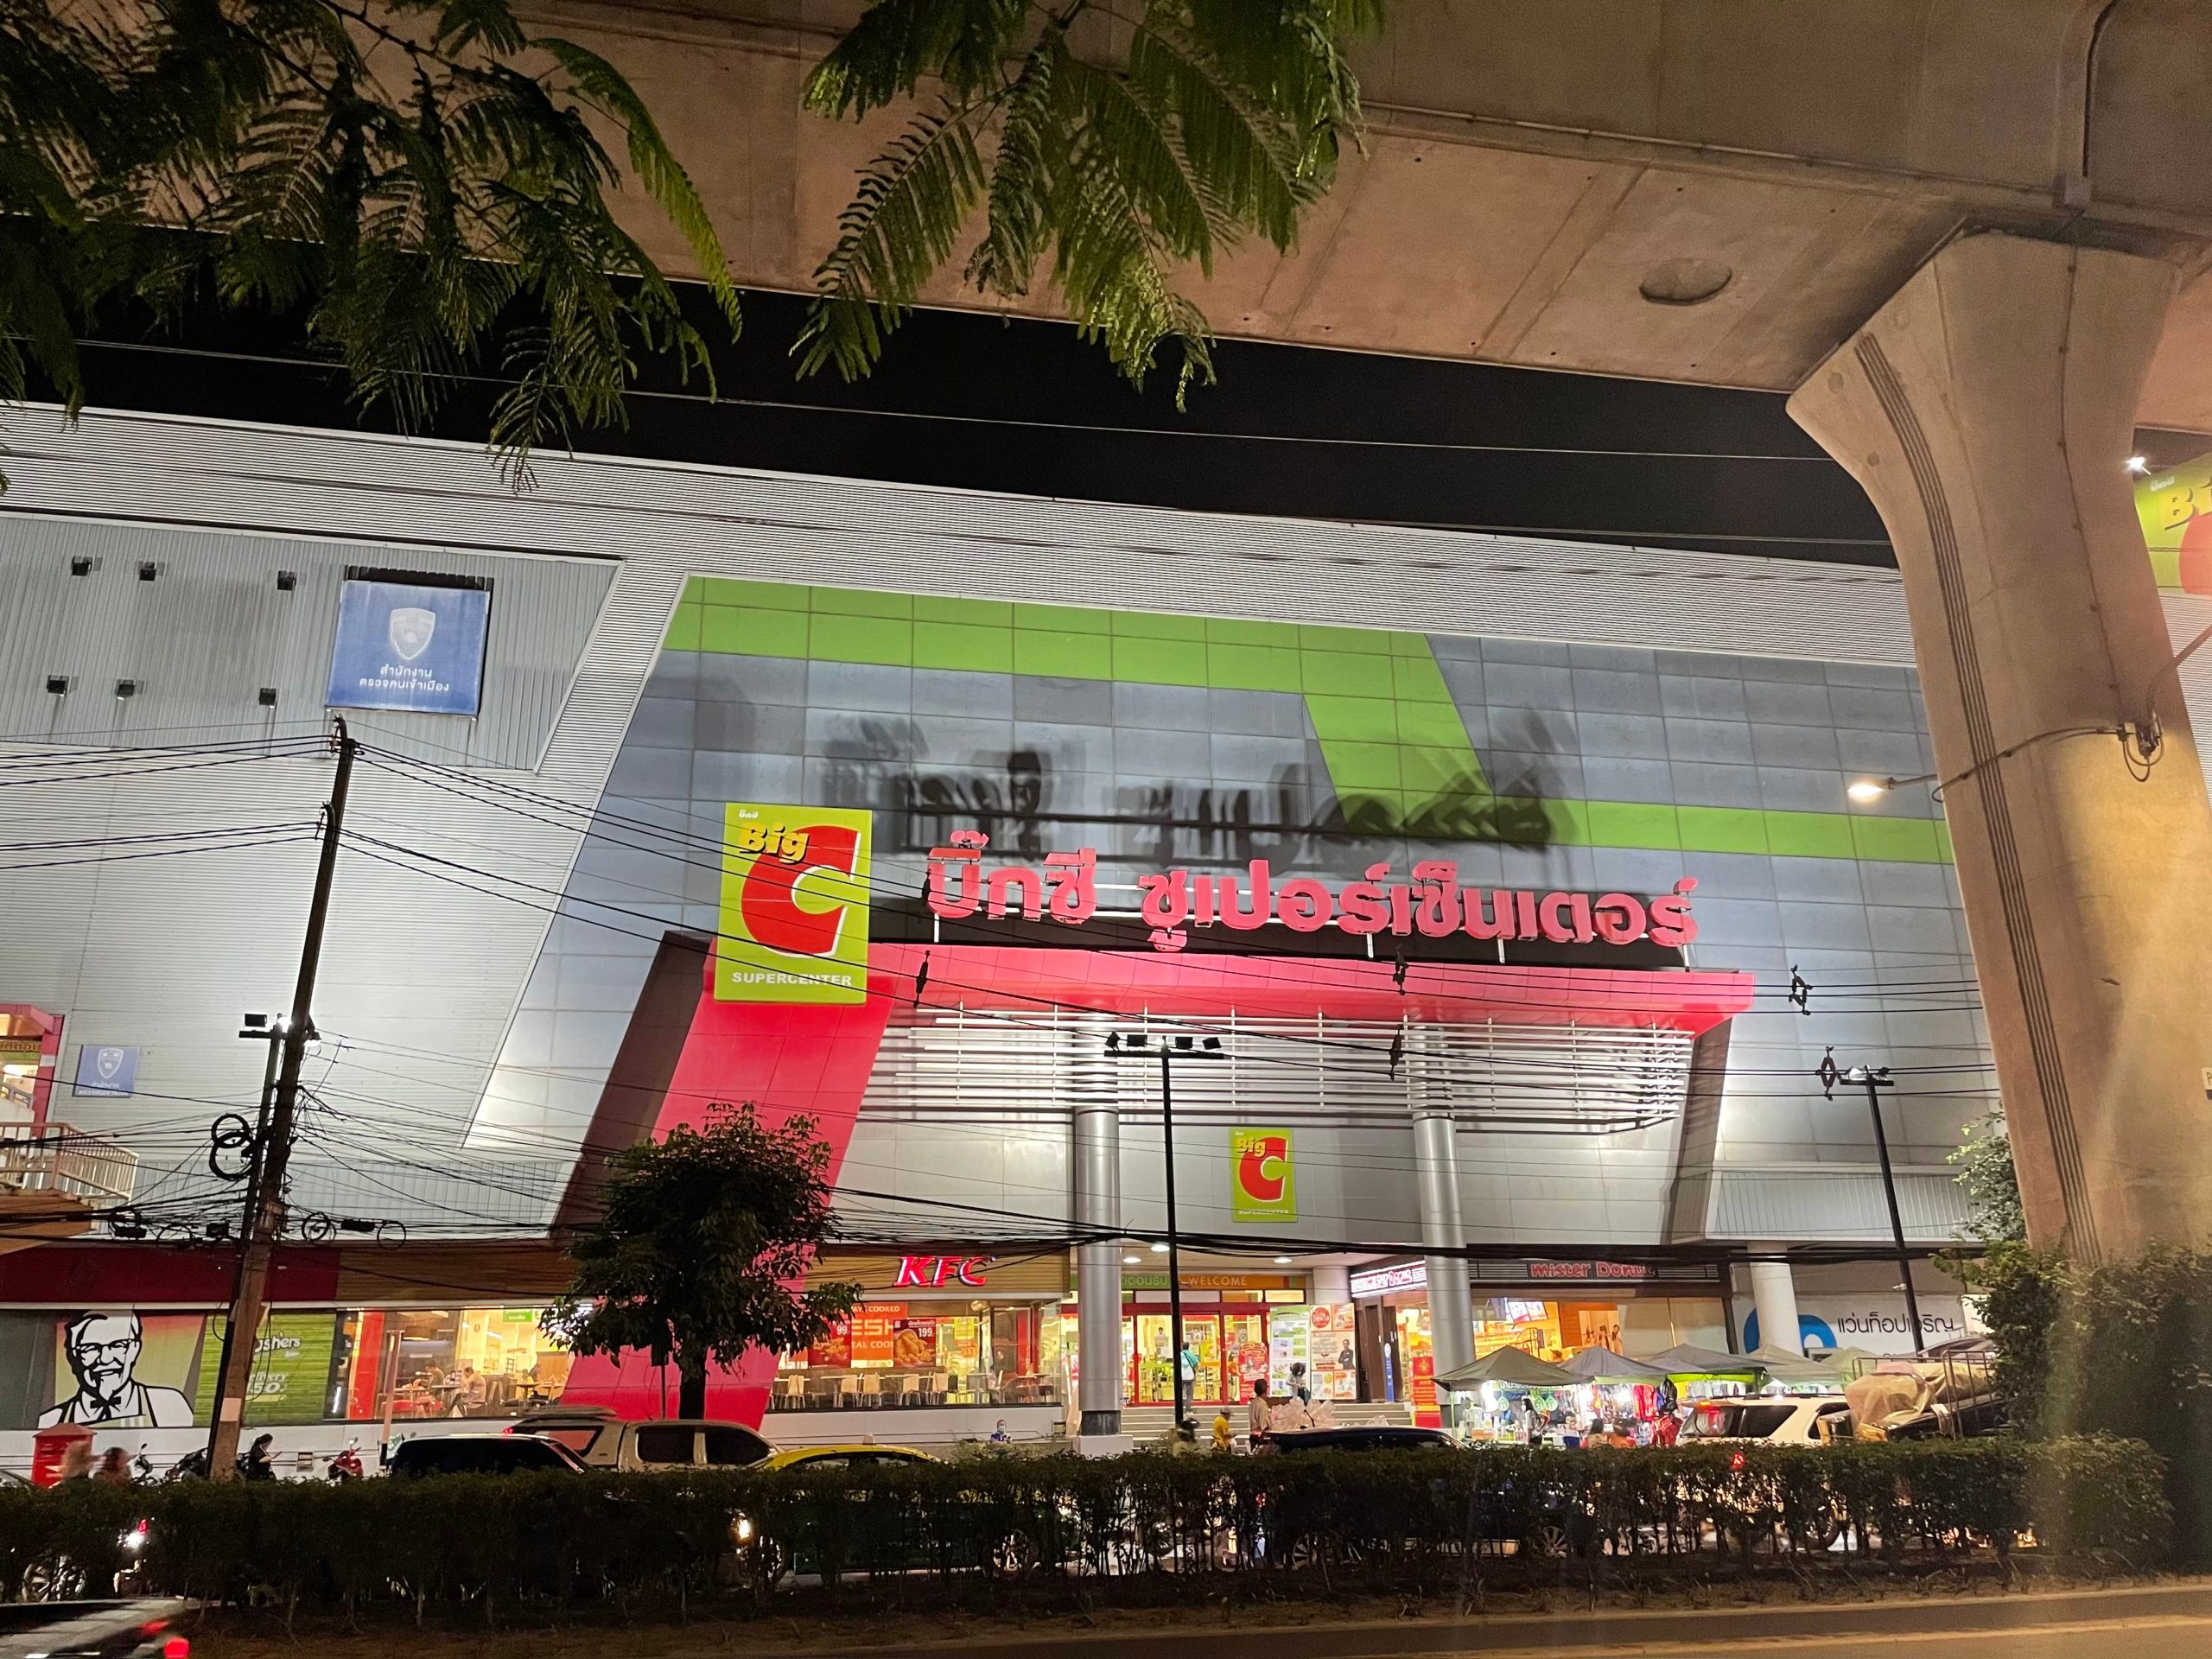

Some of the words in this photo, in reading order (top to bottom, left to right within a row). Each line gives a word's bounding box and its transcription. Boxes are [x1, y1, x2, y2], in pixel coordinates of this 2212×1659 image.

[380, 664, 432, 677] สำนักงาน
[359, 677, 449, 691] ตรวจคนเข้าเมือง
[740, 821, 810, 864] Big
[926, 830, 1097, 925] บิ๊กซี
[1139, 859, 1700, 952] ซูเปอร์เซ็นเตอร์
[732, 971, 853, 986] SUPERCENTER
[1236, 1137, 1267, 1158] Big
[893, 1255, 988, 1287] KFC
[1531, 1263, 1591, 1277] mister
[1188, 1275, 1247, 1286] WELCOME
[1837, 1311, 1955, 1333] แว่นท็อปเริญ
